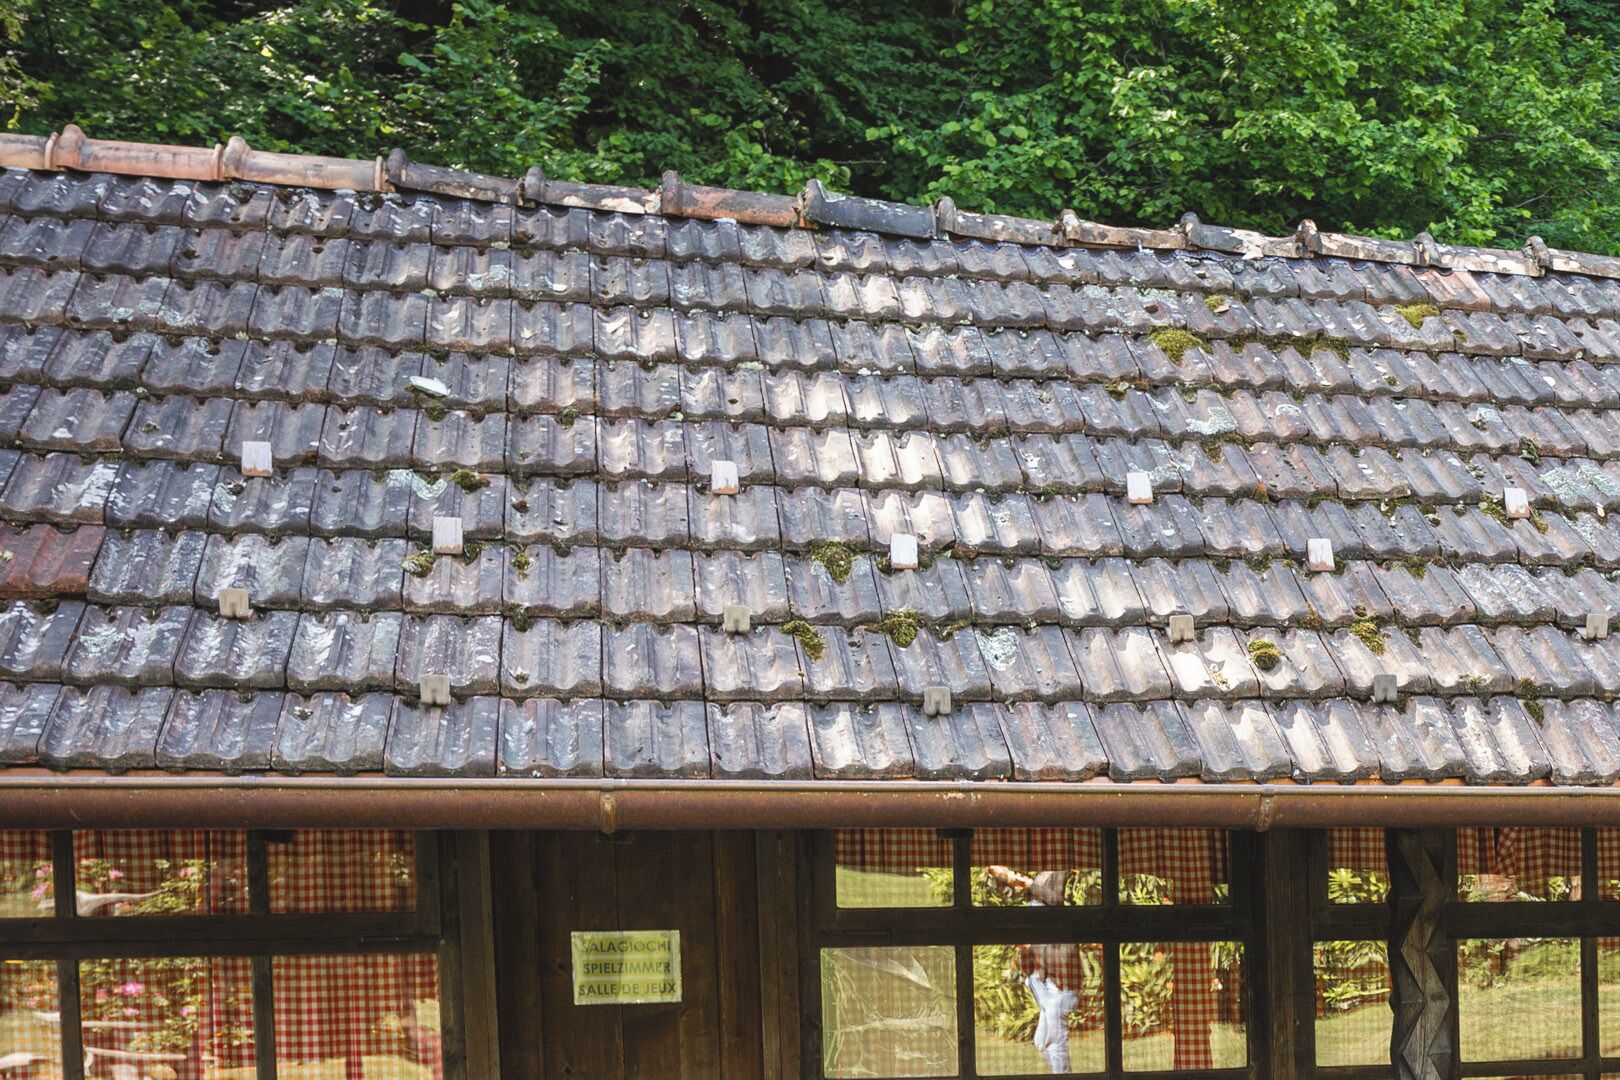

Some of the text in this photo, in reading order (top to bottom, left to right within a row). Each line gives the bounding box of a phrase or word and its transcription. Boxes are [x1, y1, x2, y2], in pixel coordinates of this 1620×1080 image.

[583, 961, 672, 975] SPIELZIMMER
[578, 982, 677, 995] SALLE DE JEUX
